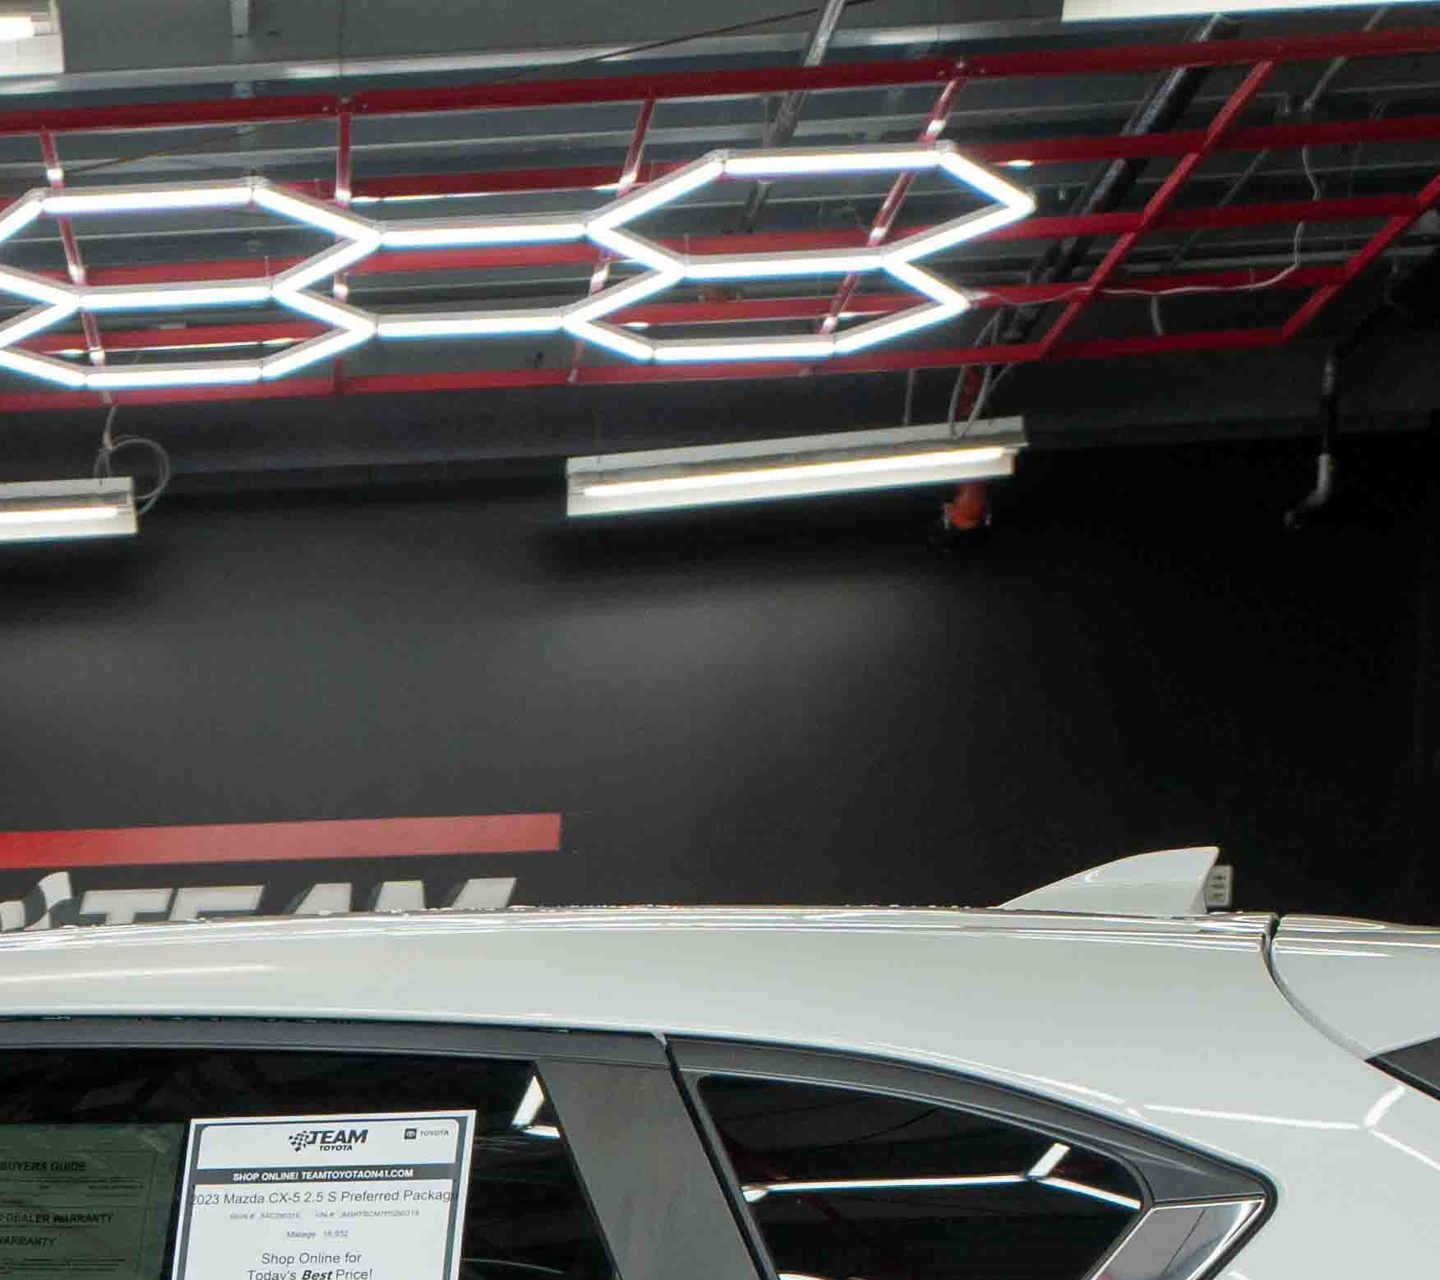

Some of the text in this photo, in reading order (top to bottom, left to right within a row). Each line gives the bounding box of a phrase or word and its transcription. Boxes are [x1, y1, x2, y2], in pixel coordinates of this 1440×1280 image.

[309, 1129, 369, 1144] TEAM
[0, 1161, 87, 1172] BUYERS GUIDE
[233, 1168, 414, 1182] SHOP ONLINE! TEAMTOYOTAON41.COM
[224, 1193, 265, 1205] Mazda
[270, 1192, 301, 1204] CX-5
[304, 1191, 324, 1203] 2.5
[328, 1191, 337, 1202] S
[341, 1190, 400, 1202] Preferred
[6, 1213, 50, 1223] DEALER
[53, 1213, 114, 1224] WARRANTY
[261, 1251, 362, 1267] Shop Online for
[301, 1269, 333, 1280] Best
[335, 1268, 373, 1280] Price!
